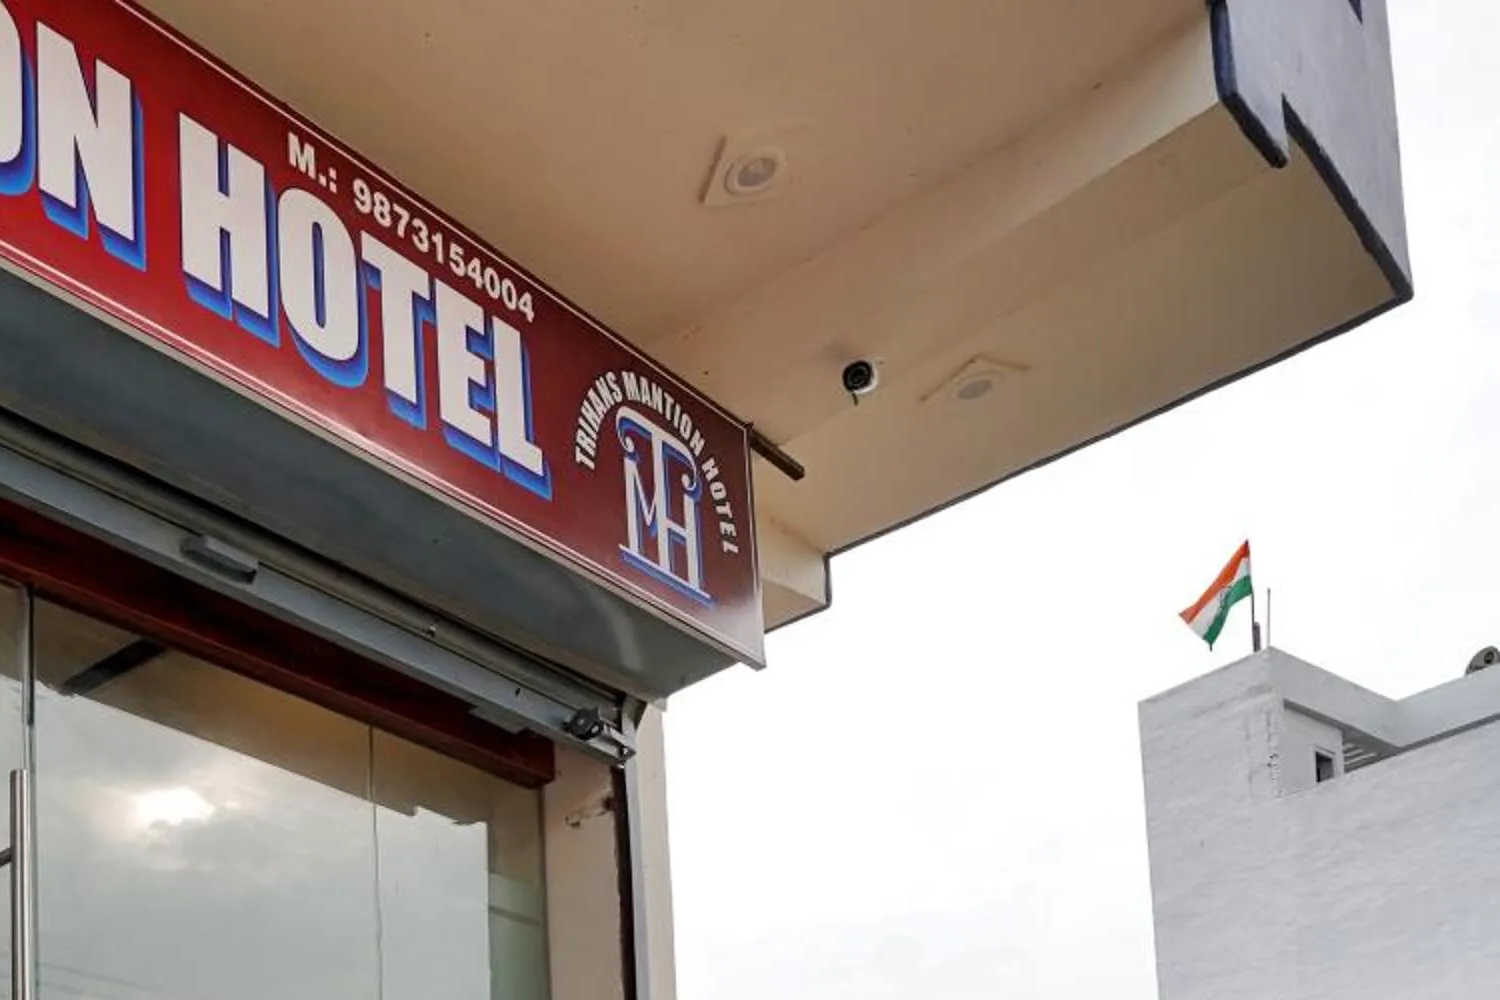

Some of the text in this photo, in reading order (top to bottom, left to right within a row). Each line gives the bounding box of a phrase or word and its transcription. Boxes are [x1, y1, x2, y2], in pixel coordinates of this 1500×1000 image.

[179, 111, 551, 500] HOTEL
[353, 178, 535, 323] 9873154004
[621, 370, 706, 457] MANTION
[701, 457, 740, 554] HOTEL
